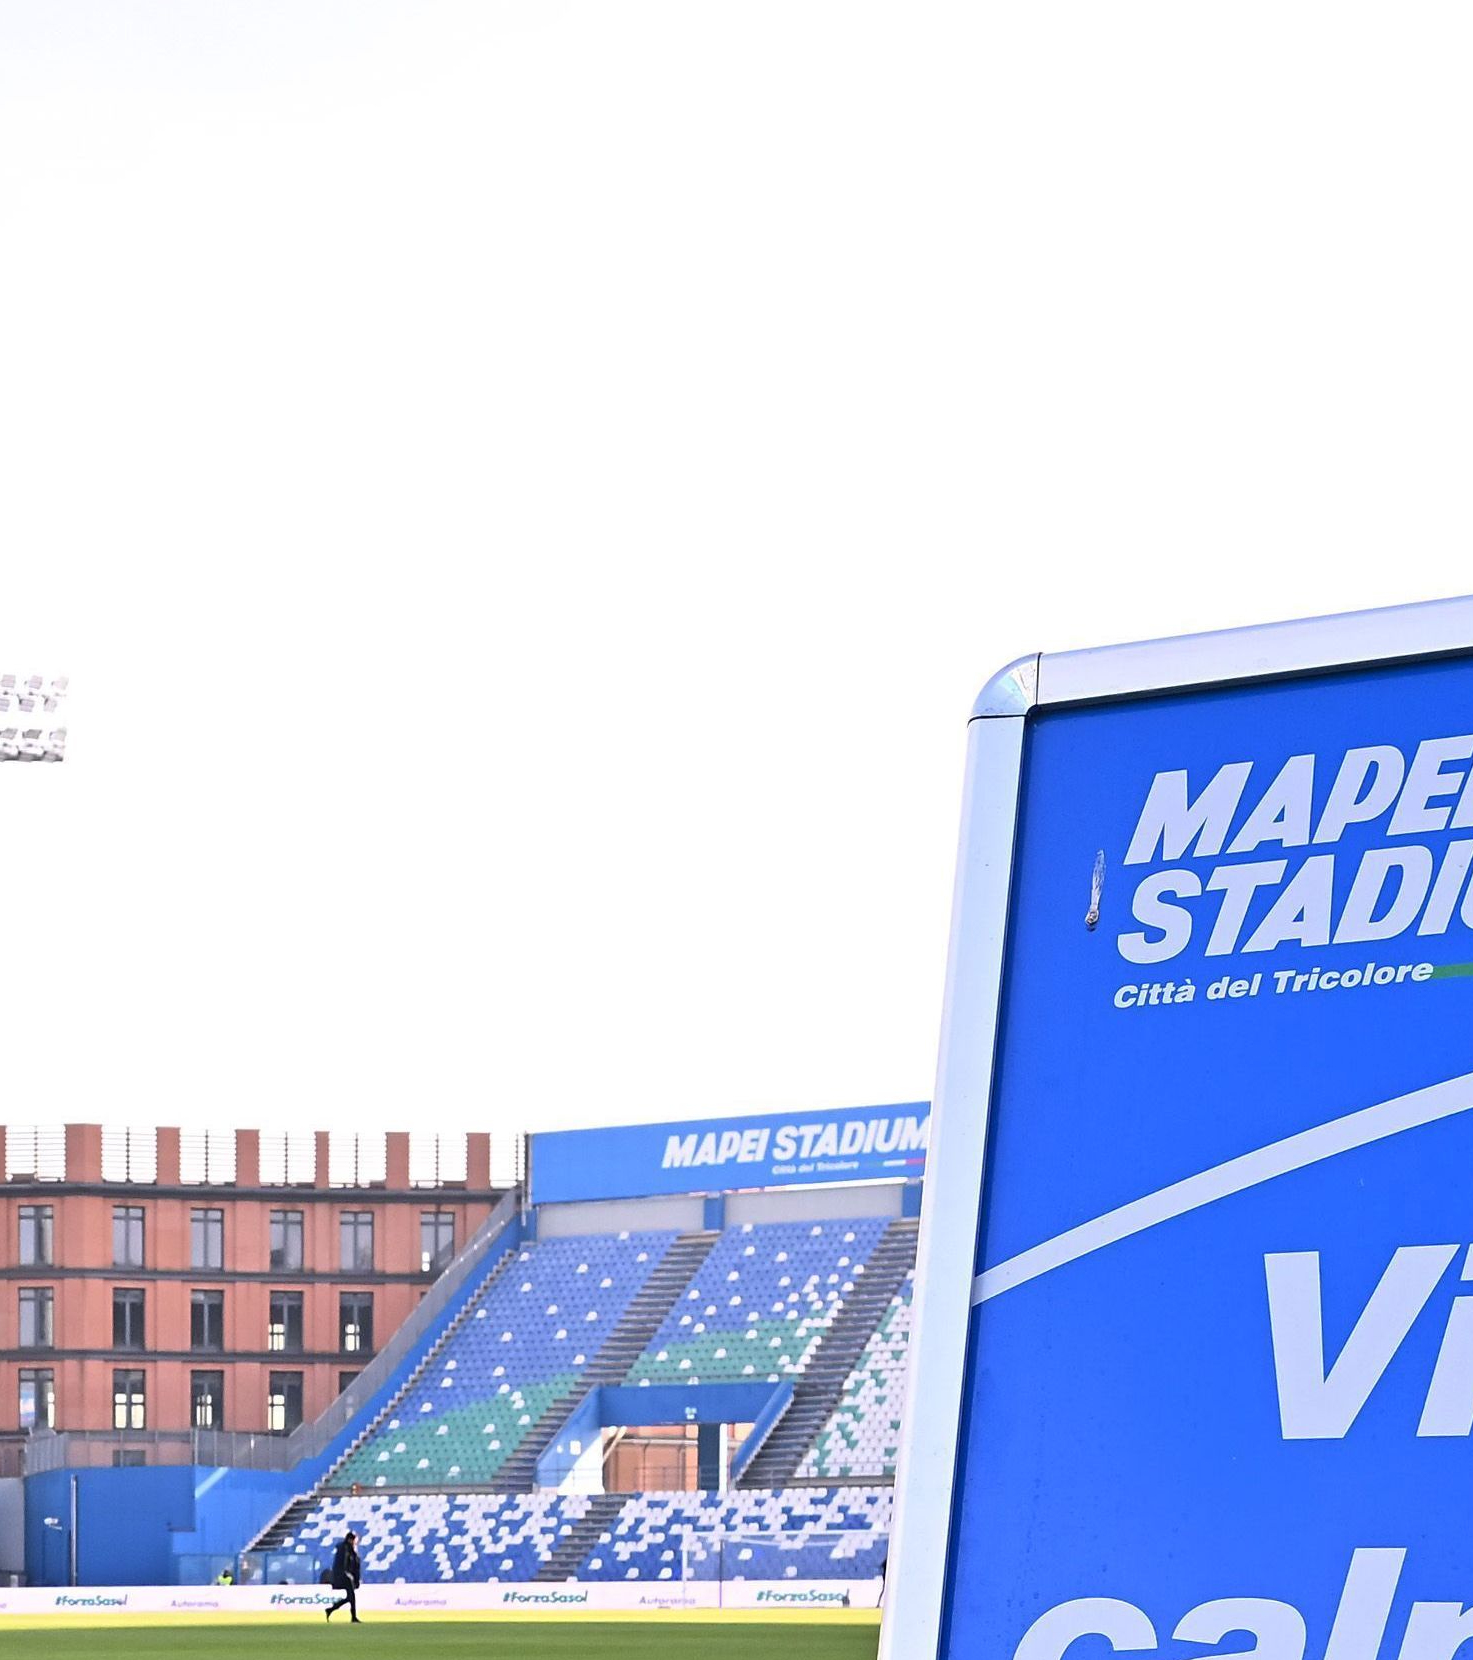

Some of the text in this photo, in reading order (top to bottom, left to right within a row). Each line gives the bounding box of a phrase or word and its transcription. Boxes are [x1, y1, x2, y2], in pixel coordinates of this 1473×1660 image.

[1113, 961, 1433, 1009] Città del Tricolore
[662, 1115, 930, 1168] MAPEI STADIUM
[502, 1590, 589, 1603] #ForzaSasol
